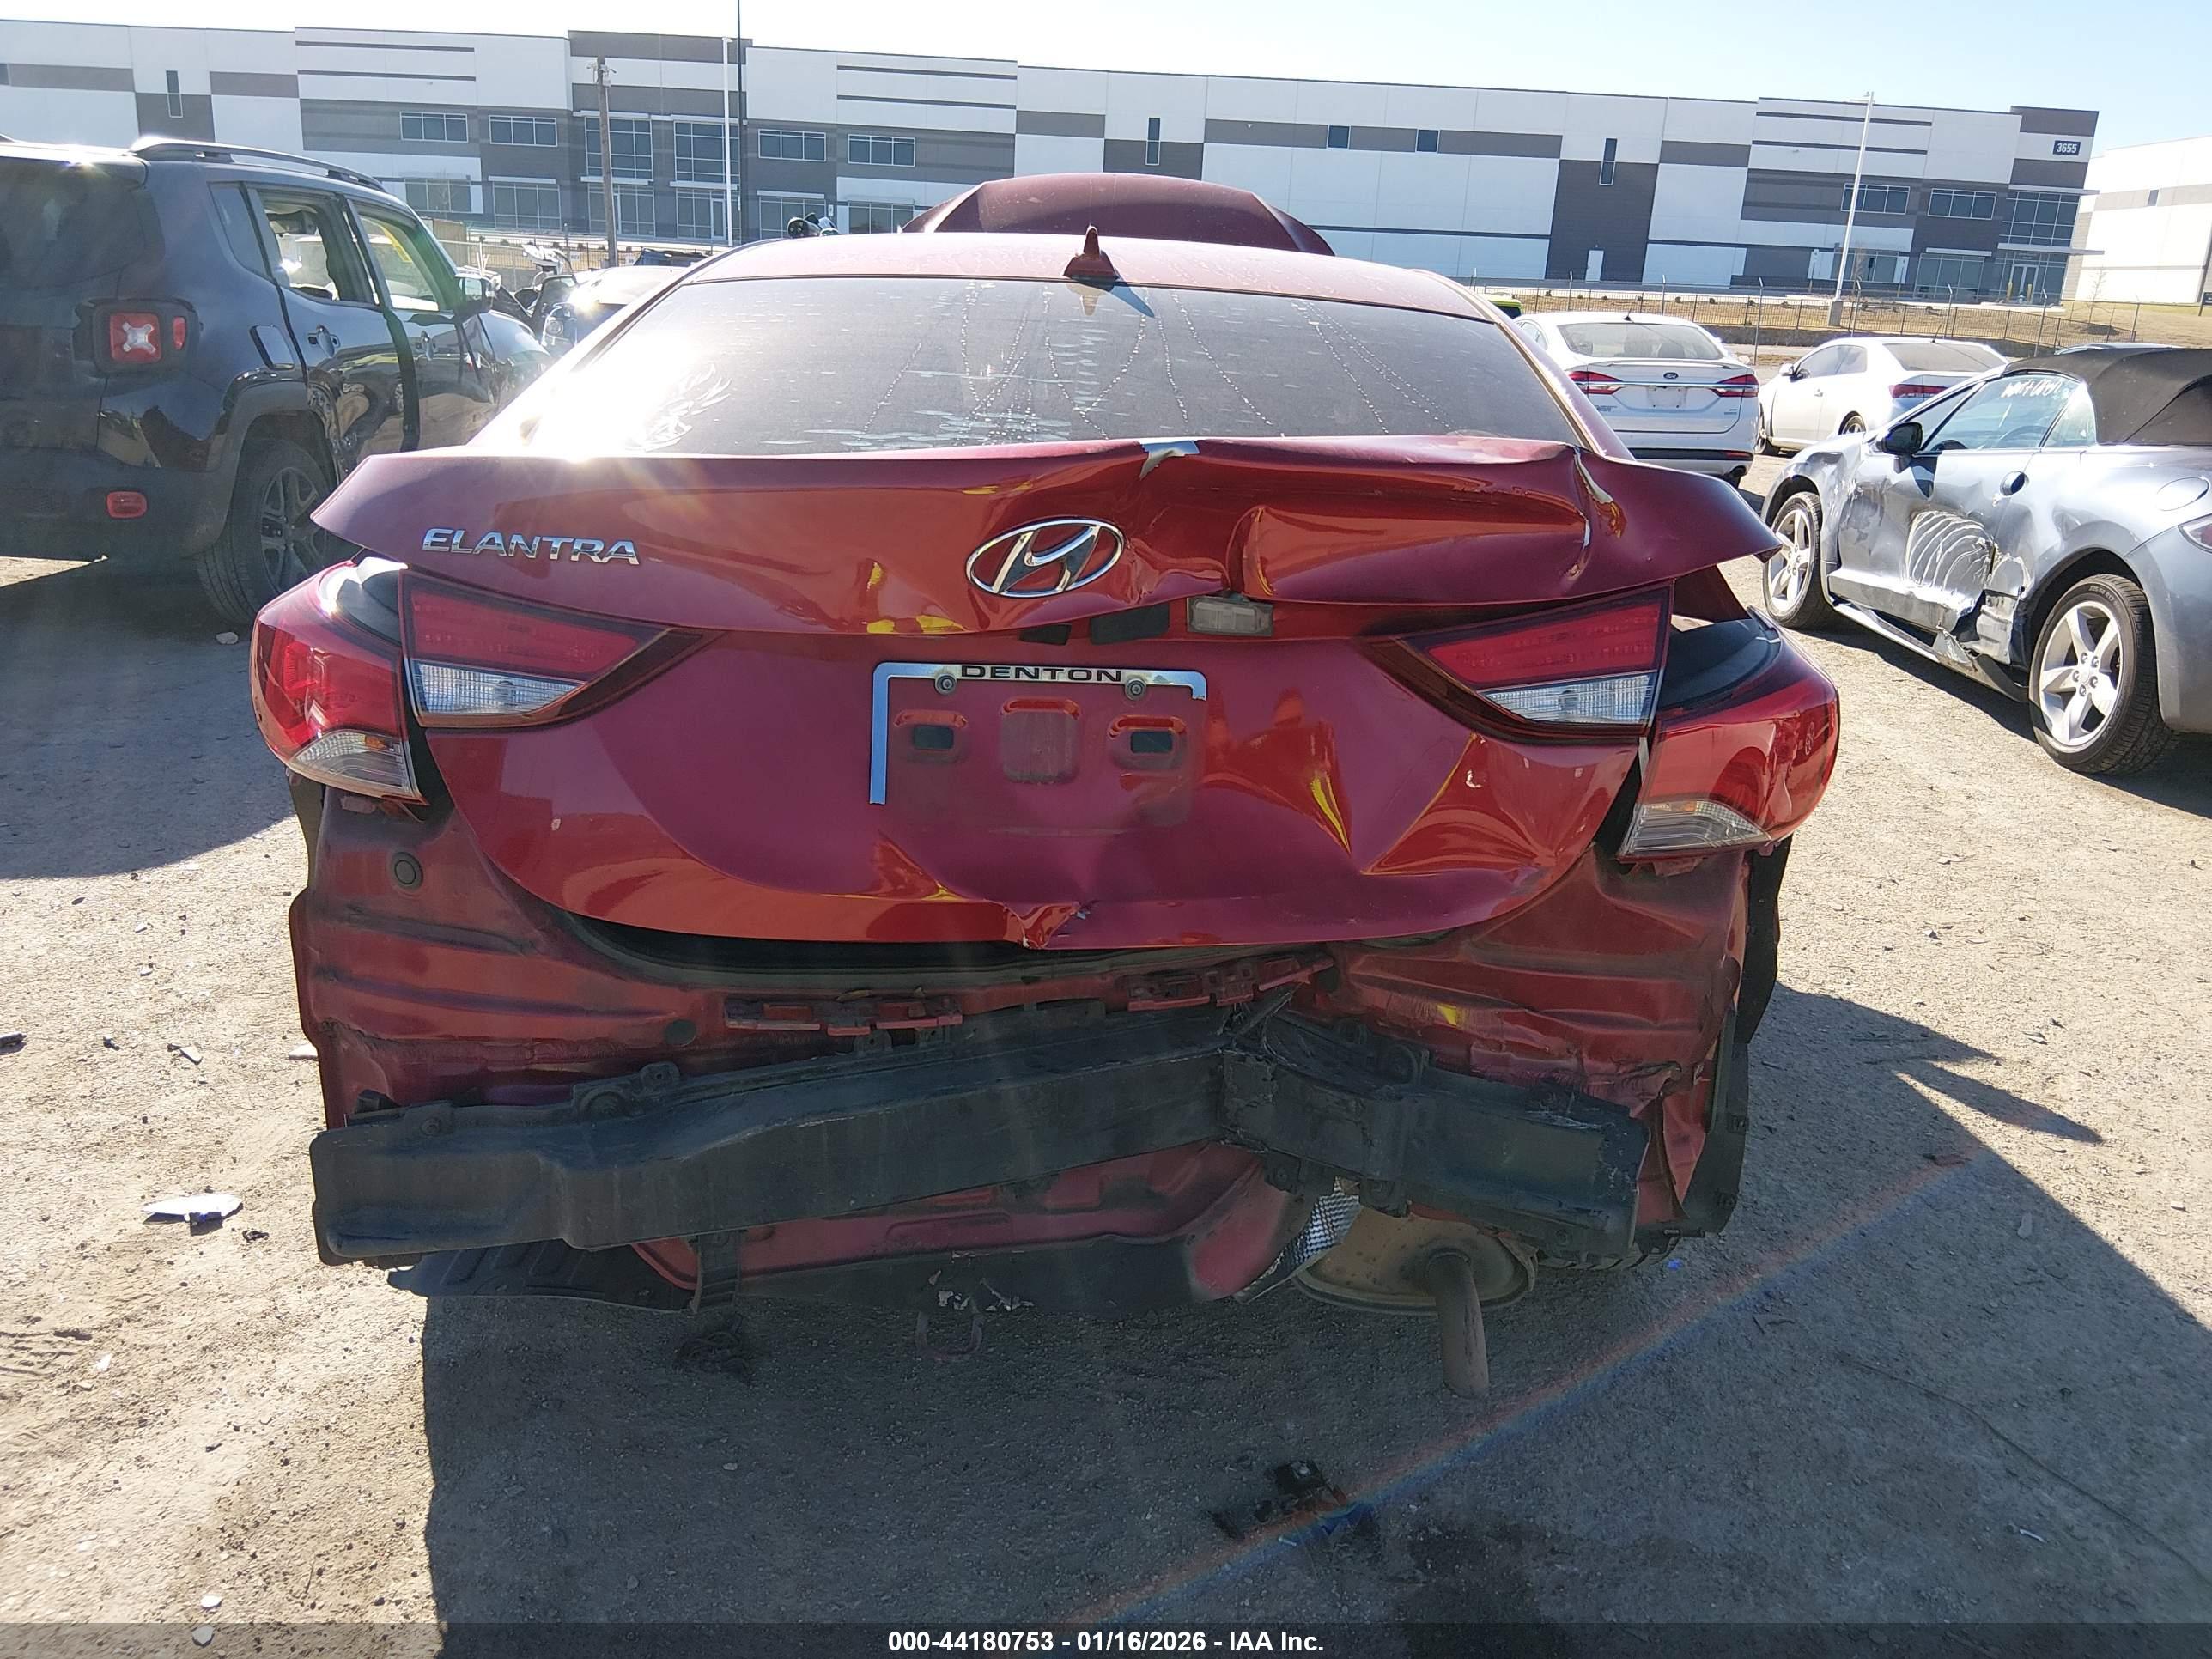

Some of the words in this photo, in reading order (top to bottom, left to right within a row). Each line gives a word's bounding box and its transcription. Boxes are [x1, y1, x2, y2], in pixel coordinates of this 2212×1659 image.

[2056, 143, 2078, 154] 3655
[422, 527, 640, 565] ELANTRA
[961, 665, 1121, 682] DENTON
